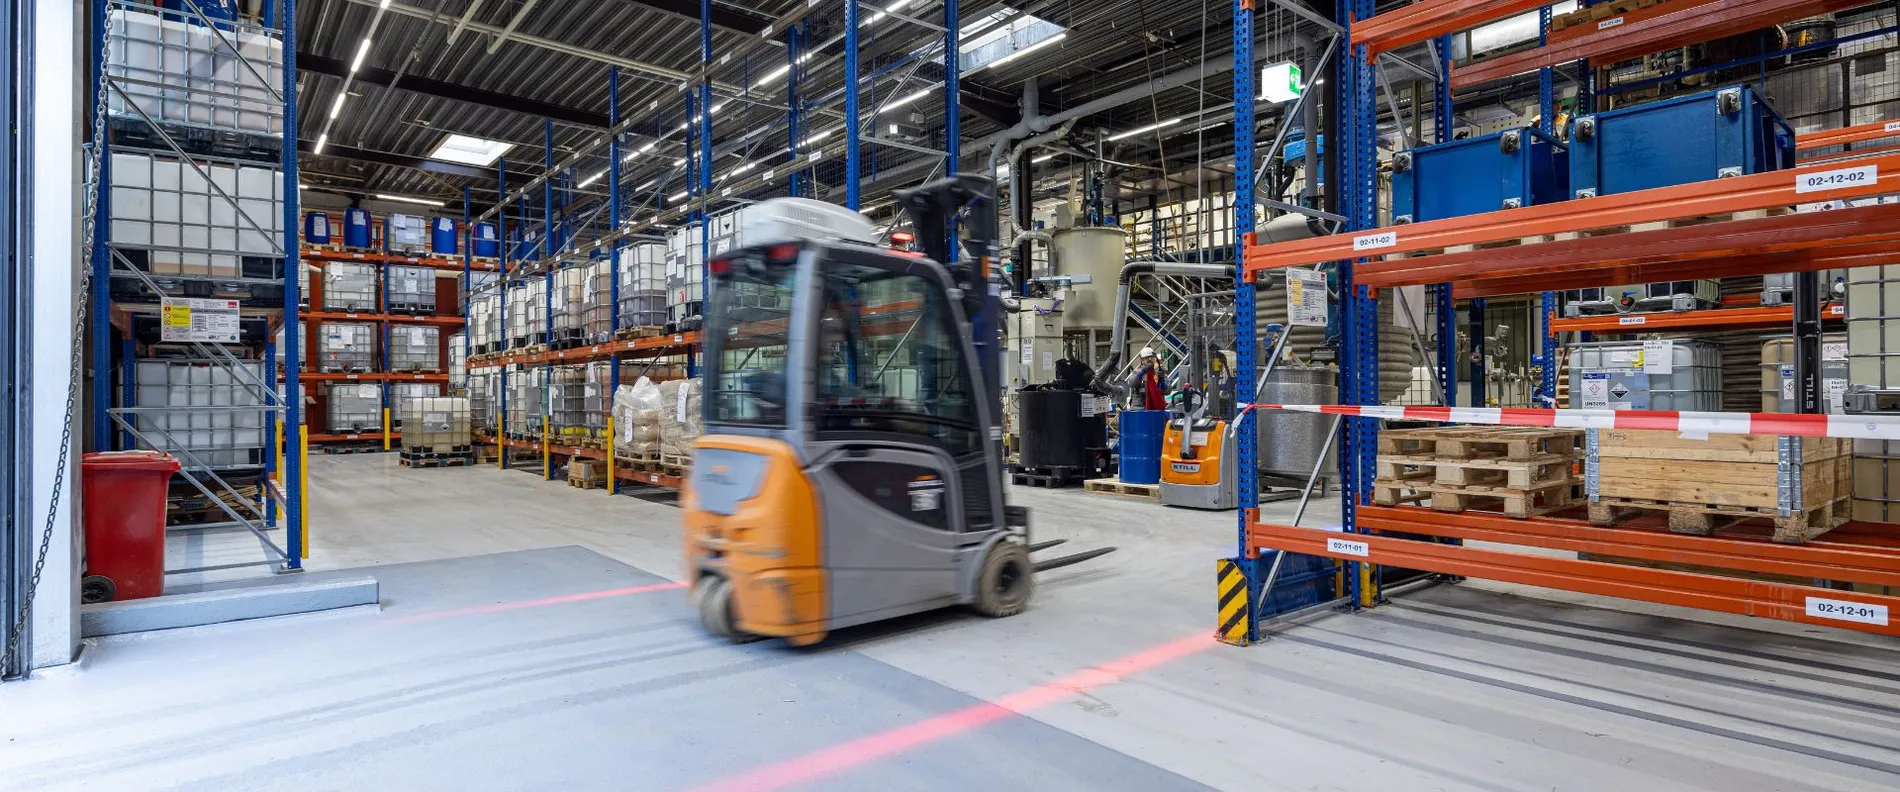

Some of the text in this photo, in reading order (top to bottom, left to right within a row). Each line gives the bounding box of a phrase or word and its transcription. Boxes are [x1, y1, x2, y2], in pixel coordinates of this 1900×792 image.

[1808, 171, 1865, 187] 02-12-02
[1359, 236, 1390, 247] 02-11-02
[1806, 373, 1814, 409] STILL
[1333, 542, 1362, 552] 02-11-01
[1818, 603, 1874, 618] 02-12-01
